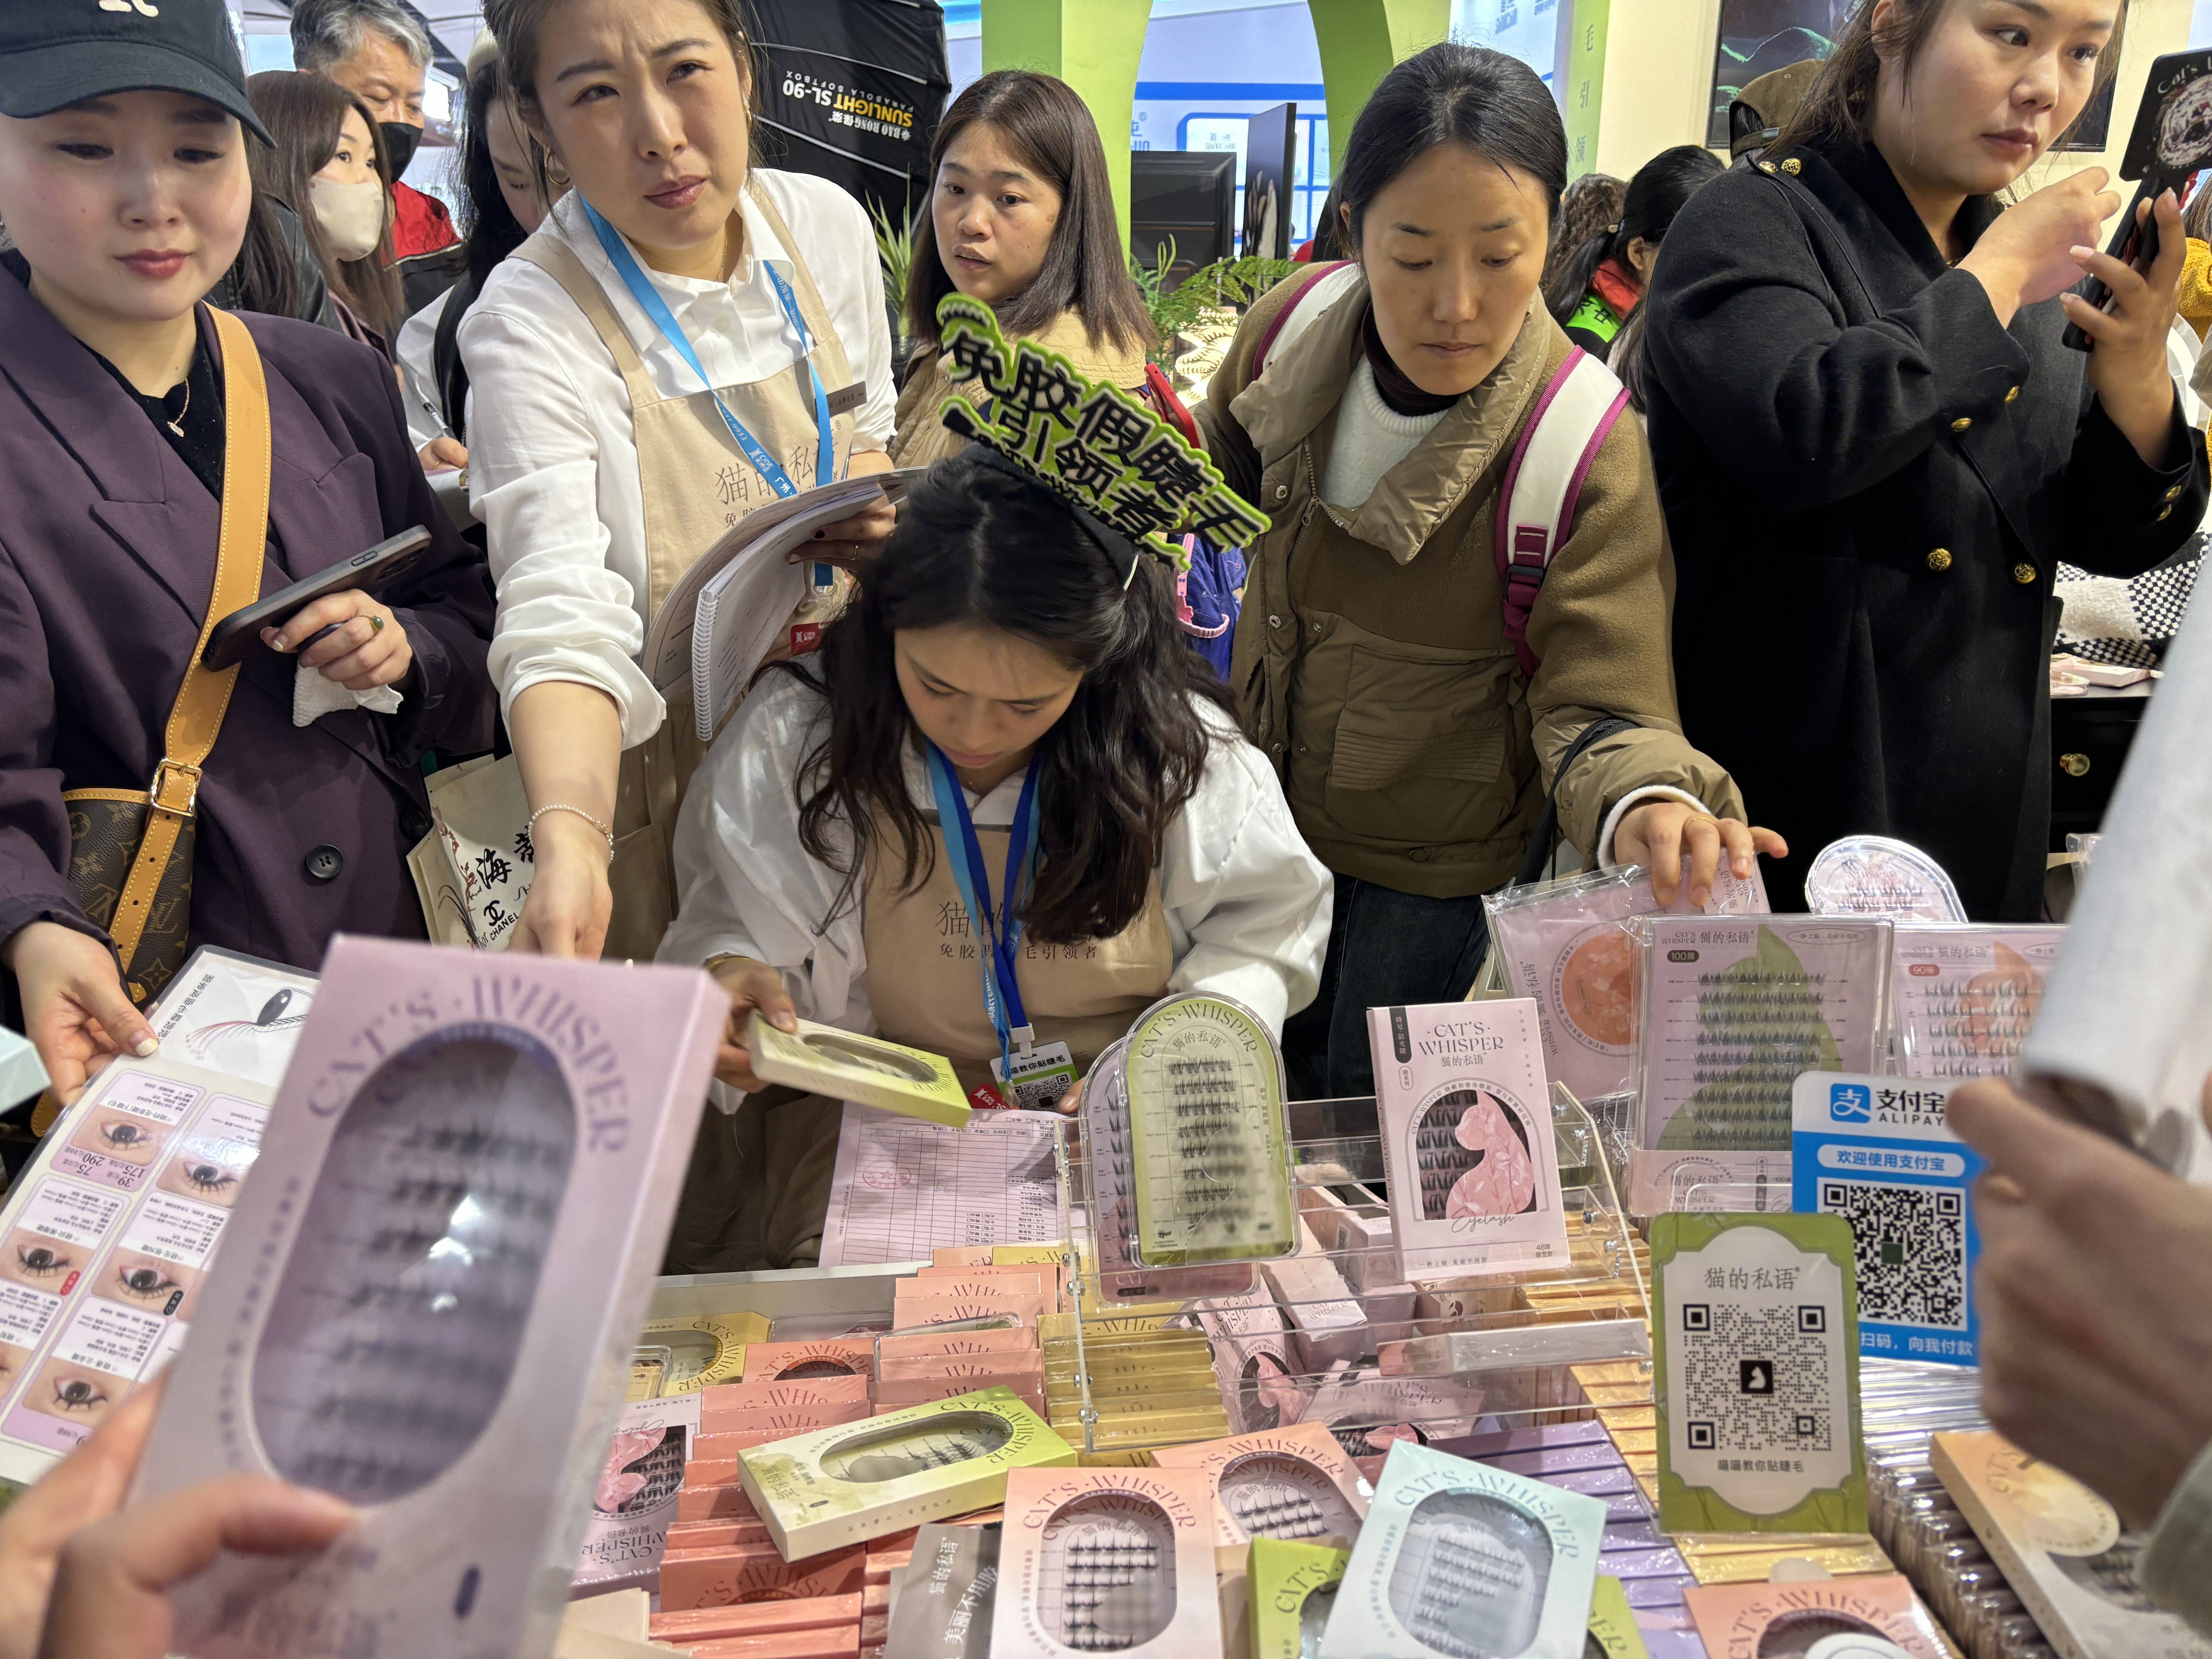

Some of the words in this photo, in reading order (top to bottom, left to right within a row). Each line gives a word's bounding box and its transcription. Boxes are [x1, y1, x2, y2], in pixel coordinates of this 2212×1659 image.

[783, 79, 832, 106] SL-90
[785, 71, 844, 93] SOFTBOX
[833, 93, 913, 127] SUNLIGHT
[850, 89, 914, 112] PARABOLA
[760, 454, 774, 468] CIBE
[490, 912, 519, 940] CHANEL
[1699, 931, 1750, 944] 猫的私语
[1140, 1013, 1176, 1058] CAT'S
[1182, 1003, 1258, 1053] WHISPER
[1173, 1030, 1223, 1051] 猫的私语
[1433, 1021, 1484, 1037] CAT'S
[1418, 1036, 1504, 1056] WHISPER
[1441, 1055, 1485, 1067] 猫的私语
[1876, 1089, 1945, 1114] 支付宝
[1879, 1113, 1944, 1127] ALIPAY
[1837, 1151, 1945, 1171] 欢迎使用支付宝
[1451, 1203, 1516, 1234] Eyelash
[1704, 1267, 1796, 1291] 猫的私语
[692, 1320, 735, 1341] CAT'S
[678, 1343, 739, 1392] WHISPER
[940, 1401, 1008, 1413] CAT'S
[989, 1414, 1035, 1465] WHISPER
[1229, 1439, 1344, 1475] WHISPER
[1717, 1460, 1803, 1474] 喵喵教你贴睫毛
[1022, 1482, 1079, 1530] CAT'S
[1093, 1475, 1196, 1528] WHISPER
[1394, 1469, 1461, 1507] CAT'S
[1479, 1472, 1580, 1559] WHISPER
[601, 1546, 653, 1565] CAT'S
[928, 1539, 960, 1596] 猫的私语
[1274, 1559, 1329, 1614] CAT'S
